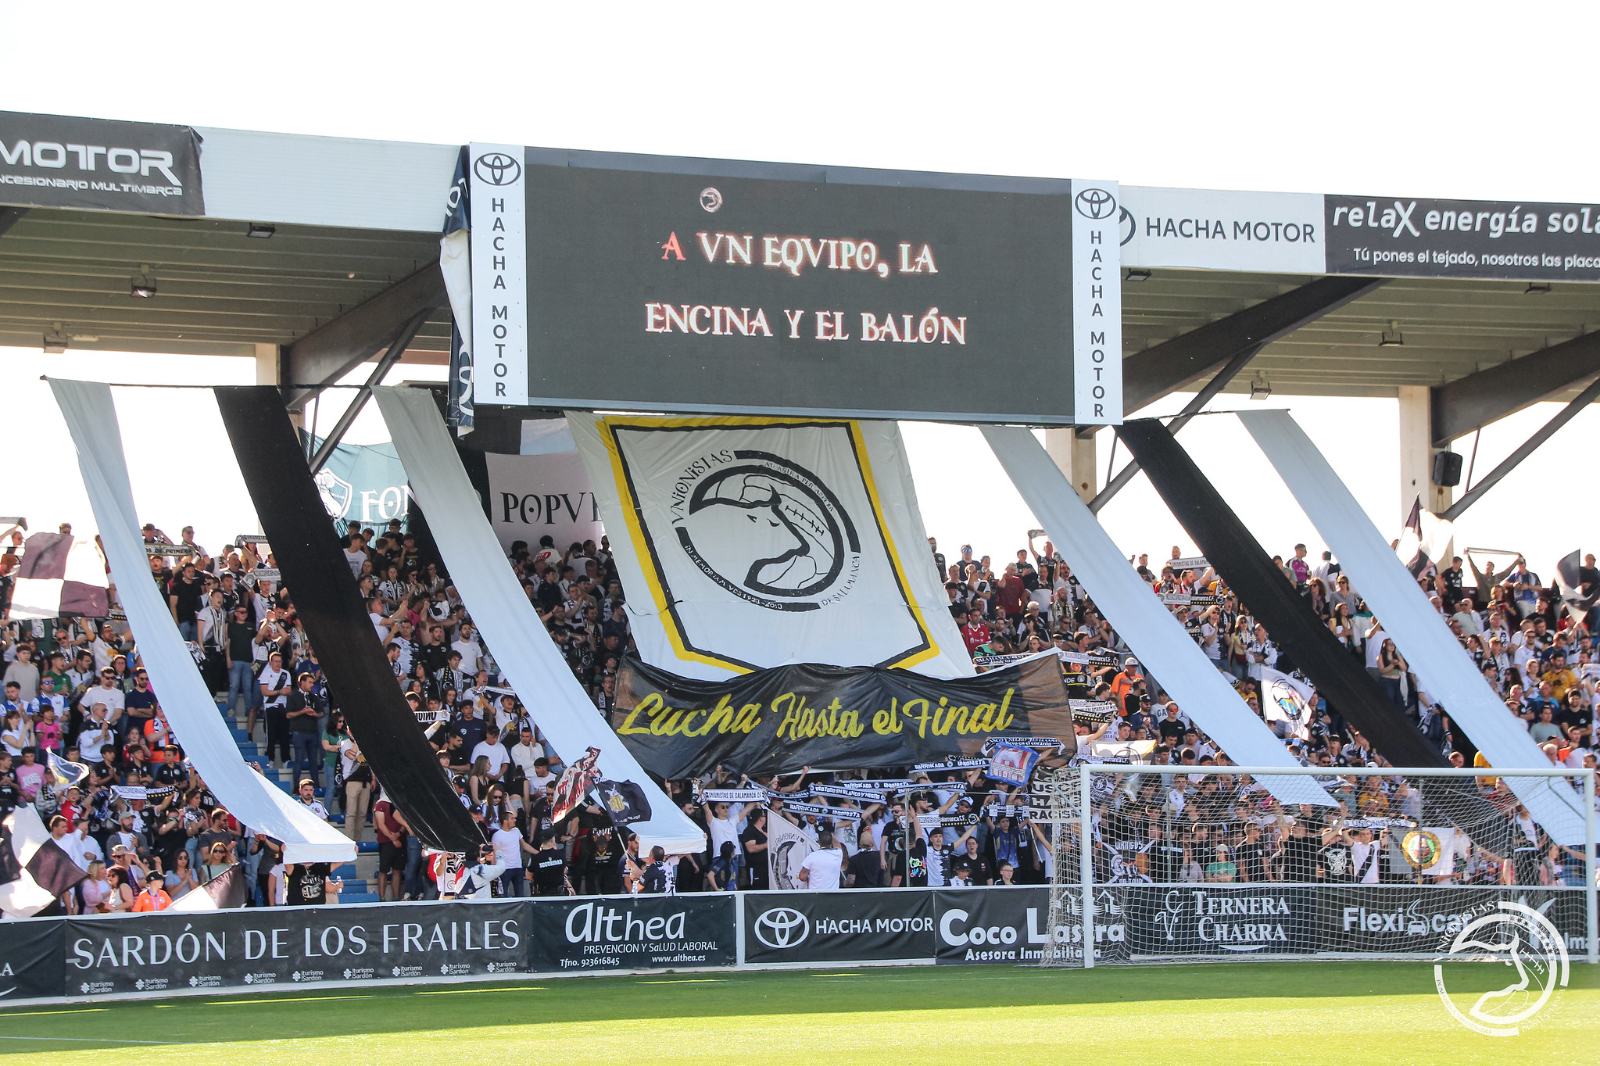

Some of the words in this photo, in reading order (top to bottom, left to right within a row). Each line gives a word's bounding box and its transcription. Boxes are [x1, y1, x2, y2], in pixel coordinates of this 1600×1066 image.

[0, 139, 183, 187] MOTOR
[91, 181, 183, 197] MULTIMARCA
[1146, 217, 1226, 240] HACHA
[1233, 220, 1316, 243] MOTOR
[1424, 205, 1538, 239] energía
[491, 197, 506, 290] HACHA
[661, 231, 687, 261] A
[696, 232, 753, 265] VN
[762, 236, 890, 278] EQVIPO,
[899, 243, 939, 274] LA
[1353, 247, 1370, 262] Tú
[1373, 250, 1414, 265] pones
[1417, 250, 1429, 264] el
[1432, 250, 1479, 267] tejado,
[1481, 253, 1538, 267] nosotros
[1542, 253, 1561, 267] las
[1090, 230, 1103, 317] HACHA
[645, 302, 774, 337] ENCINA
[783, 309, 804, 339] Y
[814, 310, 850, 341] EL
[860, 307, 967, 345] BALÓN
[491, 305, 508, 397] MOTOR
[1090, 331, 1105, 418] MOTOR
[617, 693, 762, 738] Lucha
[771, 692, 865, 740] Hasta
[872, 695, 903, 734] el
[903, 688, 1014, 739] Final
[1191, 891, 1291, 916] TERNERA
[565, 902, 686, 943] althea
[816, 918, 873, 934] HACHA
[876, 916, 934, 933] MOTOR
[939, 908, 1017, 946] Coco
[1027, 907, 1125, 945] Lasra
[1198, 917, 1288, 942] CHARRA
[1343, 907, 1404, 933] Flexi
[73, 923, 227, 970] SARDÓN
[244, 927, 290, 960] DE
[304, 925, 367, 958] LOS
[382, 919, 520, 954] FRAILES
[583, 943, 640, 954] PREVENCION
[640, 943, 648, 952] Y
[678, 941, 718, 951] LABORAL
[652, 954, 706, 963] www.althea.es
[965, 948, 1016, 962] Asesora
[1020, 946, 1102, 960] Inmobiliaa
[559, 958, 579, 968] Tfno.
[581, 957, 620, 967] 923616845
[144, 982, 167, 990] Sardón
